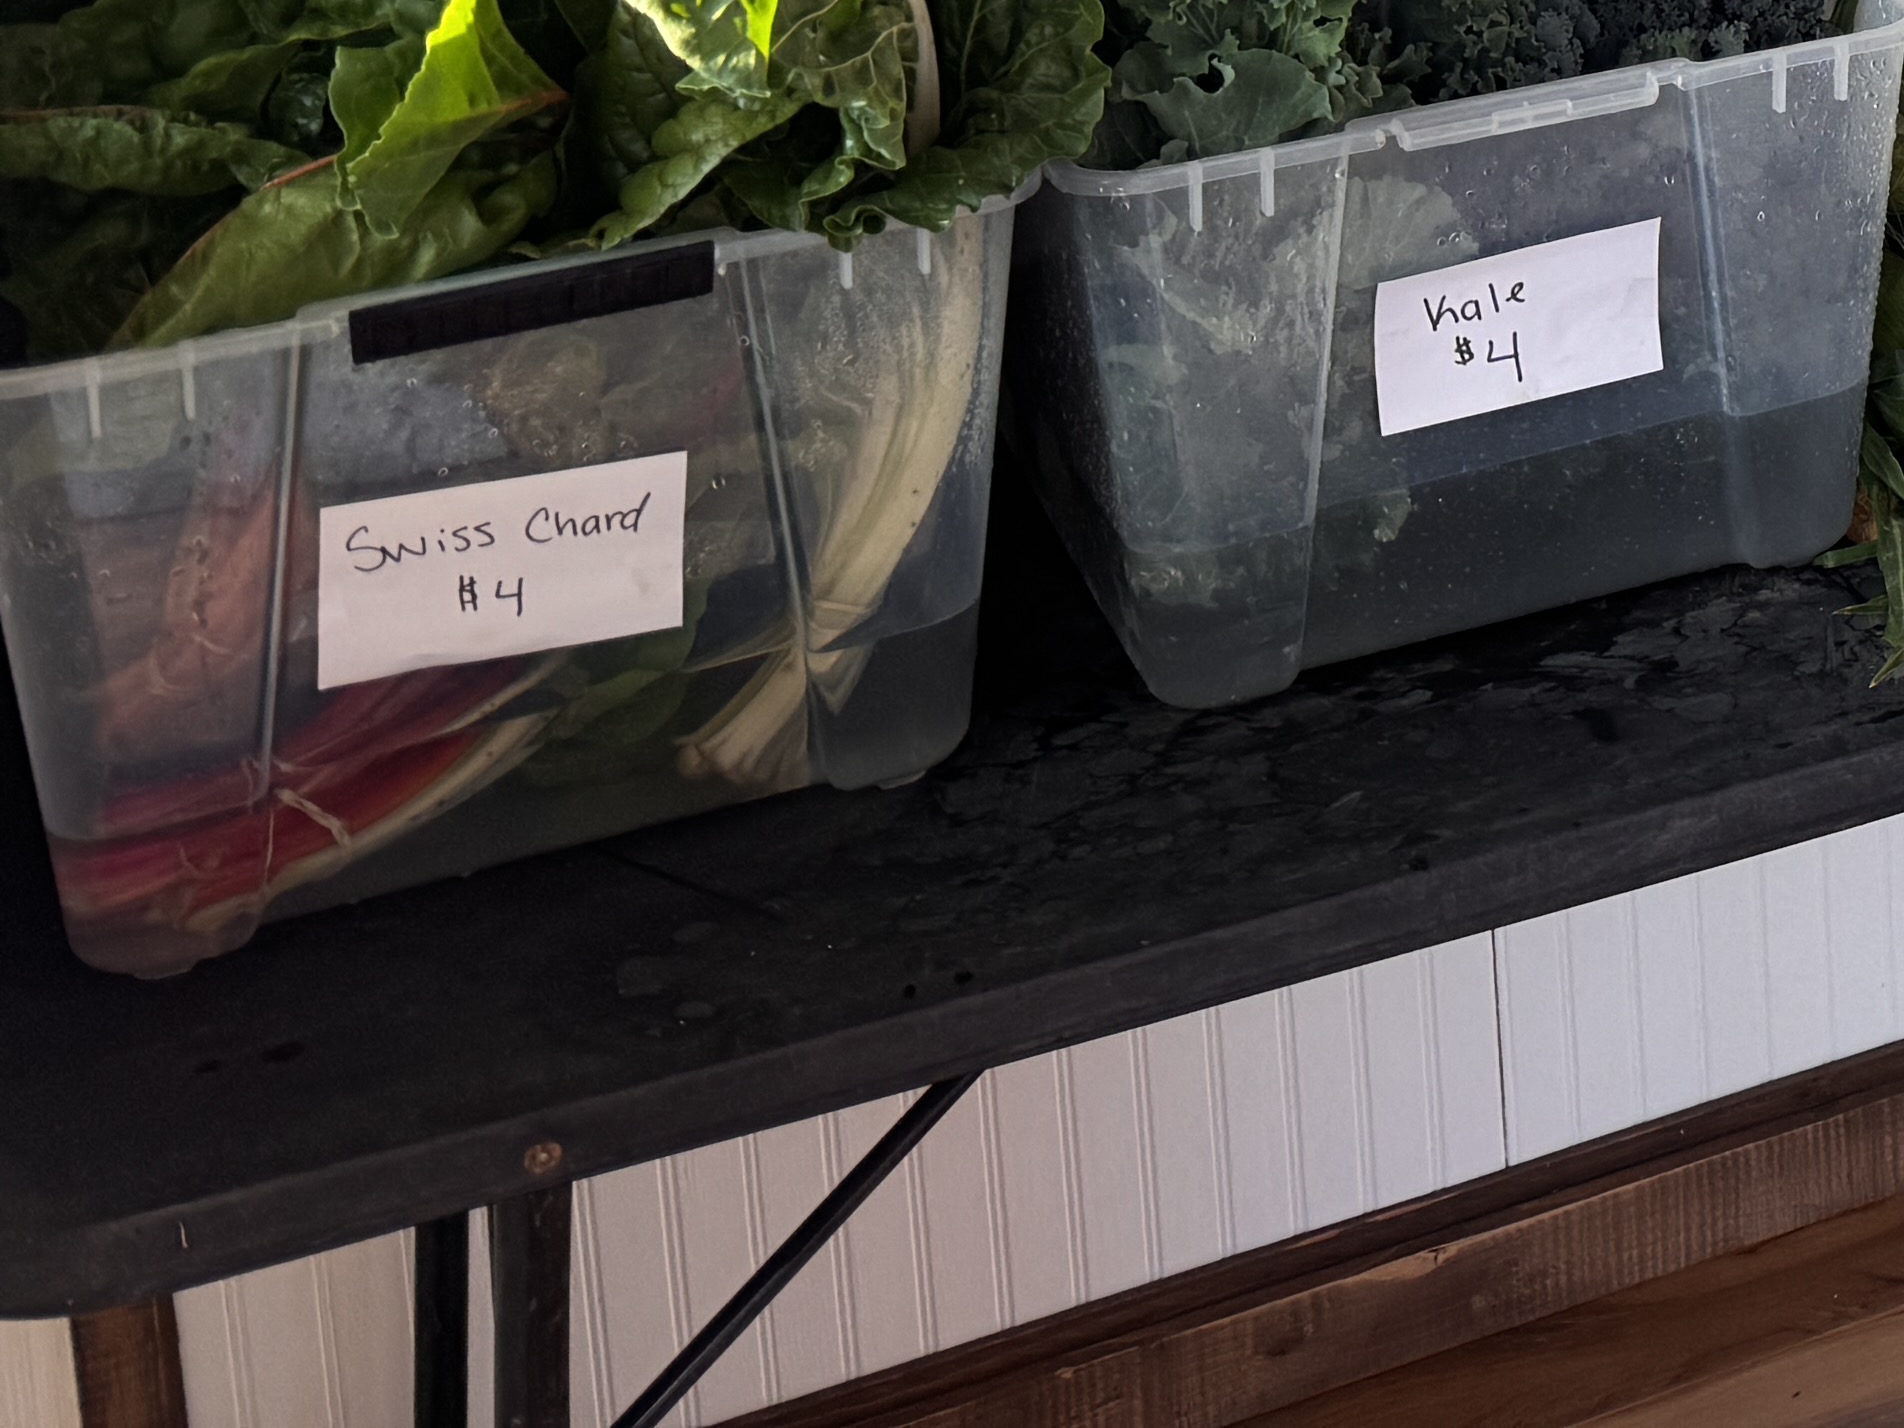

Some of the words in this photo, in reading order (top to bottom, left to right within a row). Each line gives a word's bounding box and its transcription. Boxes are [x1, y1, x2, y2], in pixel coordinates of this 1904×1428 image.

[1423, 280, 1527, 332] Kale
[1453, 330, 1524, 384] $4
[344, 520, 497, 574] Swiss
[523, 490, 653, 545] Chard
[457, 573, 525, 618] $4
